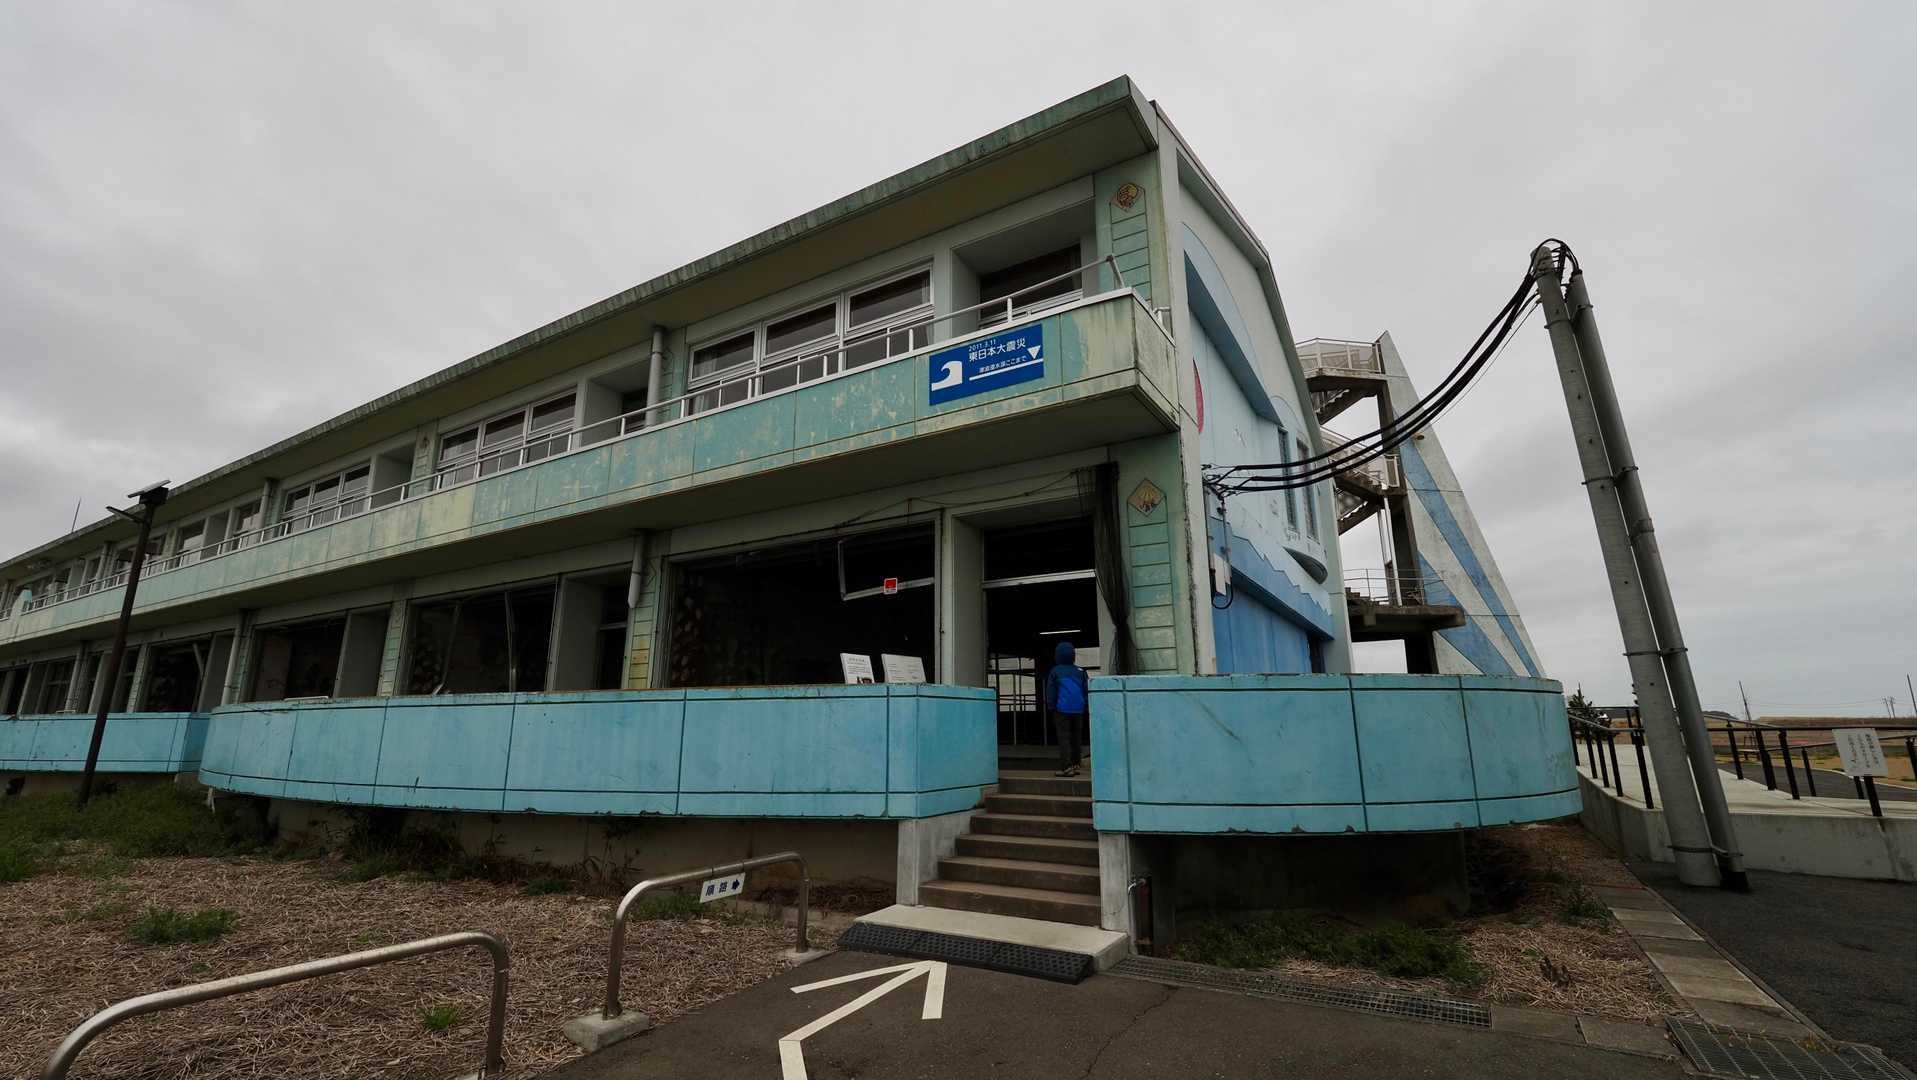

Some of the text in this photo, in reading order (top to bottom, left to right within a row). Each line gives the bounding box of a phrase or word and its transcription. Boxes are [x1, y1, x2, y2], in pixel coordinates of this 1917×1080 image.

[969, 339, 996, 352] 2011.3.11
[969, 338, 1026, 362] 東日本大震災
